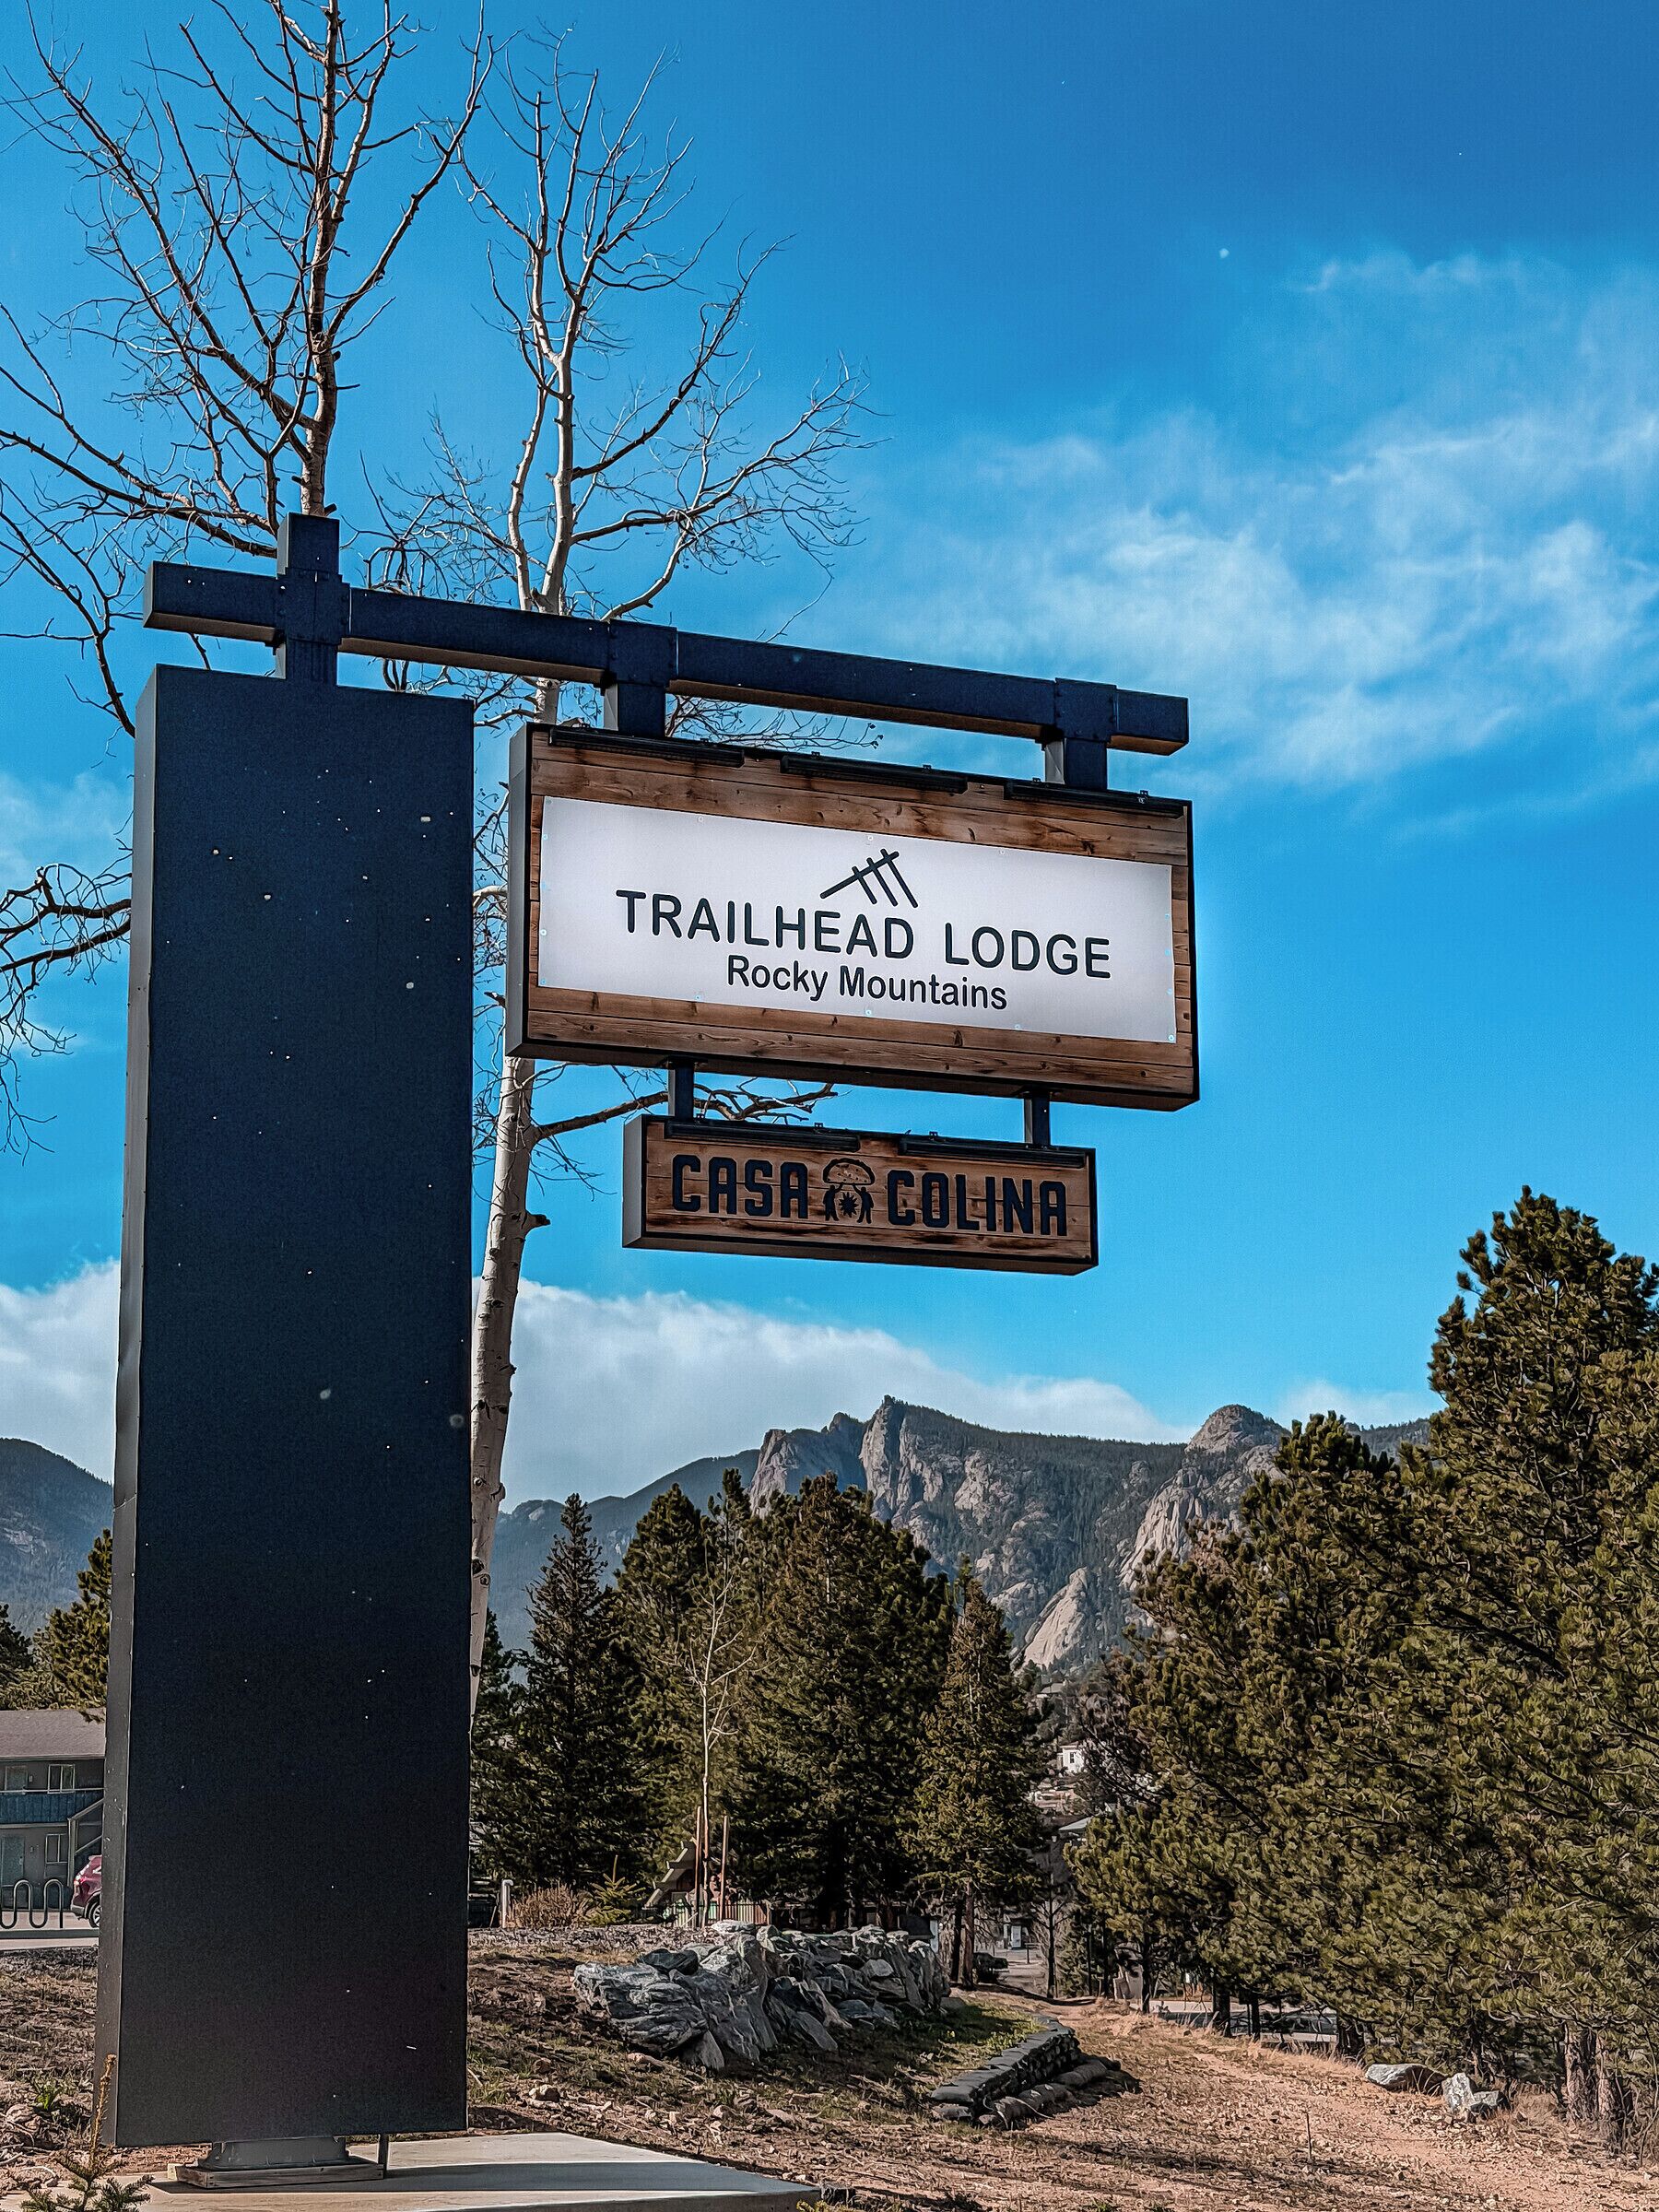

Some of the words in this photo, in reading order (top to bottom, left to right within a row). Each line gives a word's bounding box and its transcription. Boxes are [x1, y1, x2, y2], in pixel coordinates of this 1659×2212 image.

[616, 889, 914, 959] TRAILHEAD
[945, 922, 1112, 979] LODGE
[727, 954, 829, 1002] Rocky
[839, 965, 1007, 1010] Mountains
[672, 1154, 808, 1219] CASA
[888, 1170, 1067, 1236] COLINA
